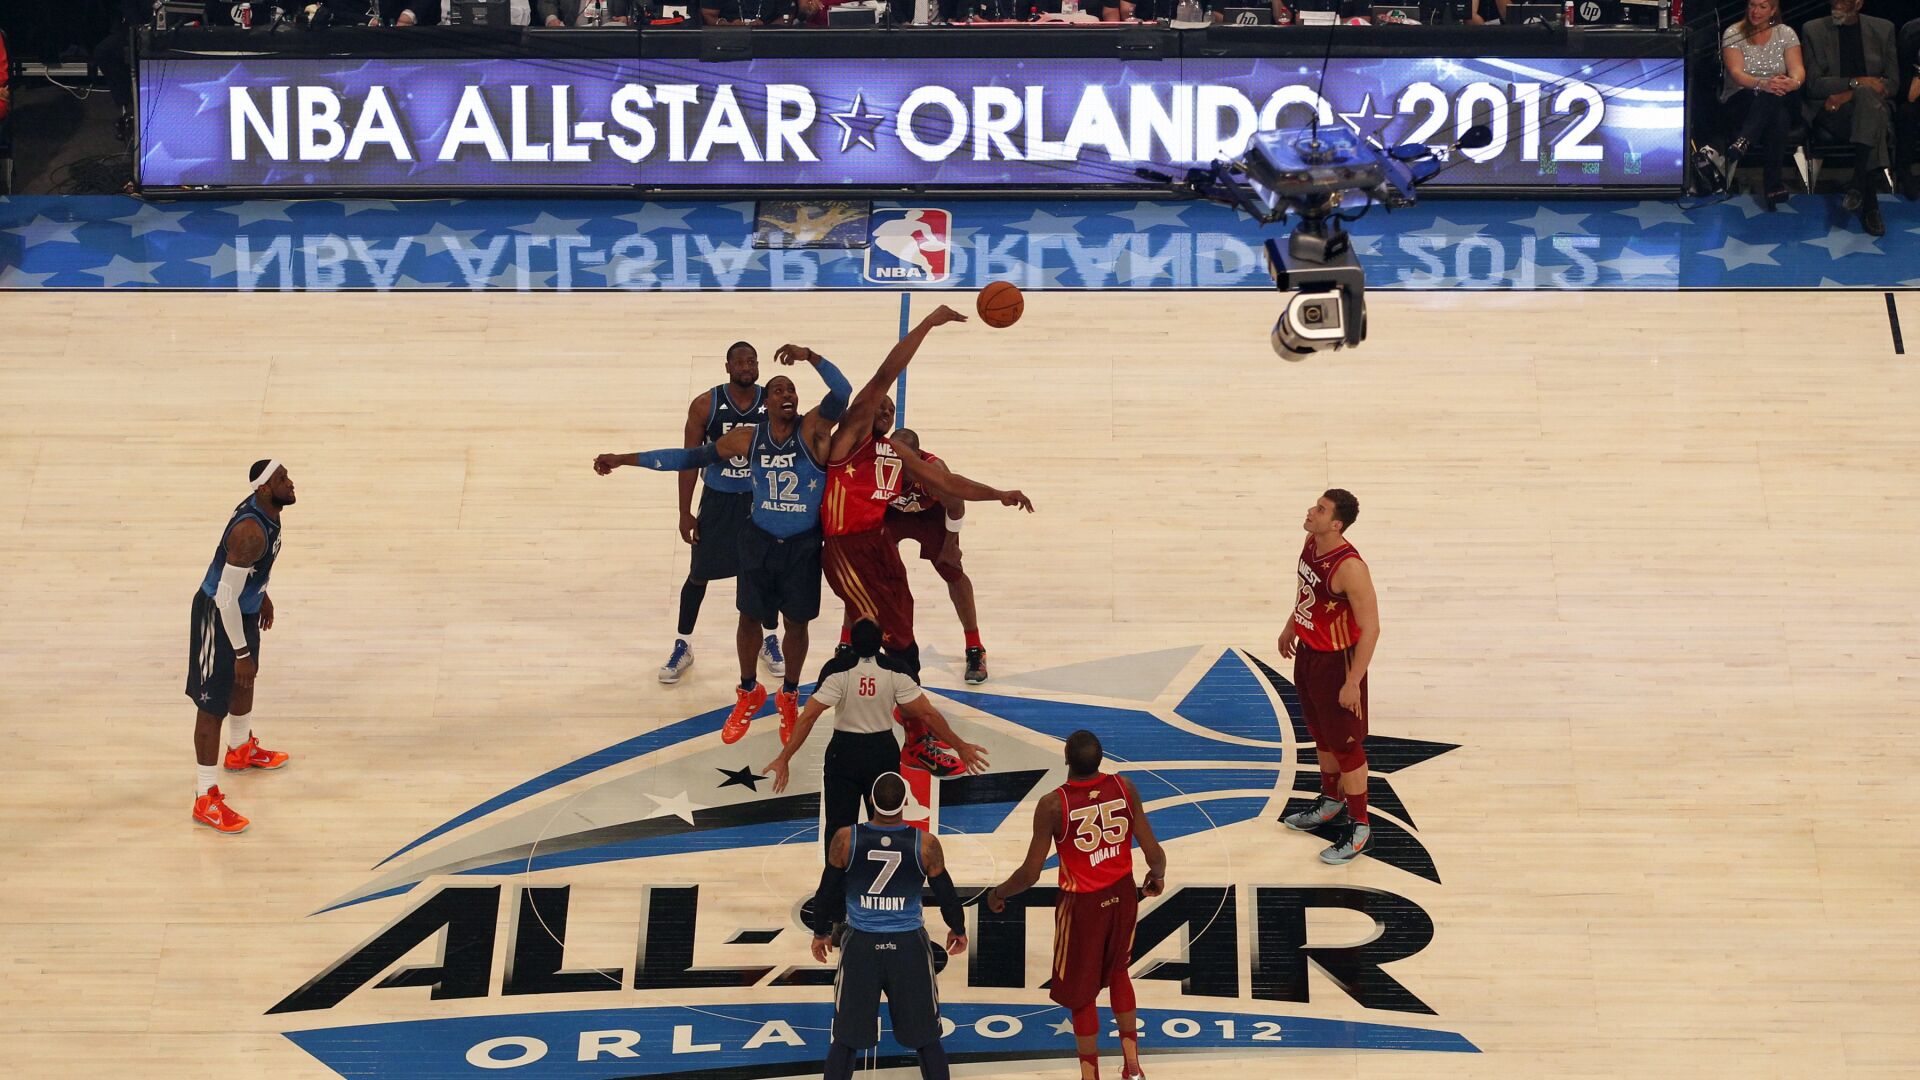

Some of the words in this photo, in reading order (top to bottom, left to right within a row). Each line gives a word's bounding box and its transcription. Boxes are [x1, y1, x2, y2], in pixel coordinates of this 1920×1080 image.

[229, 85, 415, 162] NBA
[436, 83, 821, 163] ALL-STAR
[1396, 81, 1605, 163] 2012
[876, 267, 922, 278] NBA
[760, 452, 797, 468] EAST
[874, 456, 903, 491] 17
[765, 470, 800, 501] 12
[1299, 558, 1322, 588] WEST
[858, 677, 876, 697] 55
[1069, 798, 1129, 853] 35
[1089, 844, 1121, 868] DURANT
[867, 849, 902, 895] 7
[860, 894, 906, 911] ANTHONY
[465, 1014, 1023, 1069] ORLAO
